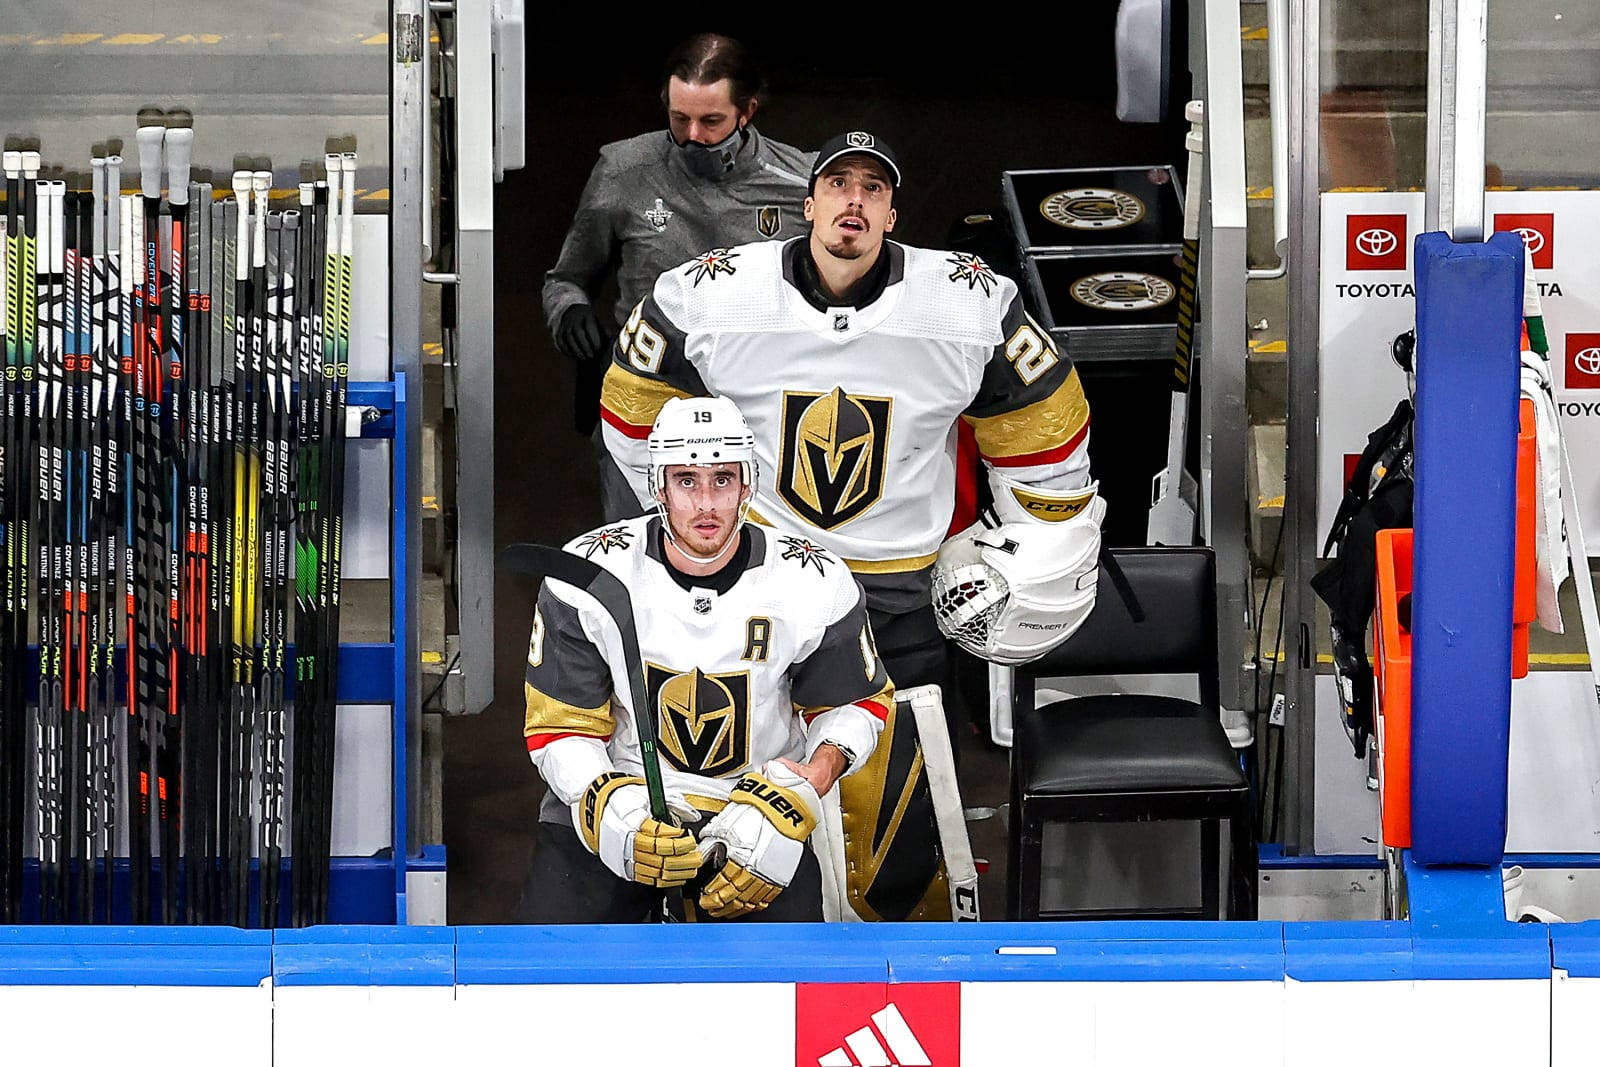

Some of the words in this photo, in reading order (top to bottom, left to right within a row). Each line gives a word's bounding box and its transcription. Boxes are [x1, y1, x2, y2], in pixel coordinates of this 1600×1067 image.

[148, 242, 156, 282] COVERT
[172, 250, 181, 342] WARROR
[1336, 284, 1416, 298] TOYOTA
[236, 315, 245, 371] CCM
[252, 316, 262, 372] CCM
[300, 315, 310, 374] CCM
[313, 314, 322, 373] CCM
[1005, 311, 1060, 386] 2
[686, 437, 723, 445] BAUER
[693, 411, 712, 423] 19
[39, 446, 49, 501] BAUER
[53, 446, 62, 501] BAUER
[93, 445, 102, 500] BAUER
[108, 439, 117, 493] BAUER
[265, 439, 275, 494] BAUER
[279, 439, 289, 494] BAUER
[189, 486, 197, 519] COVERT
[1026, 501, 1082, 513] CCM
[126, 548, 134, 581] COVERT
[741, 616, 773, 662] A
